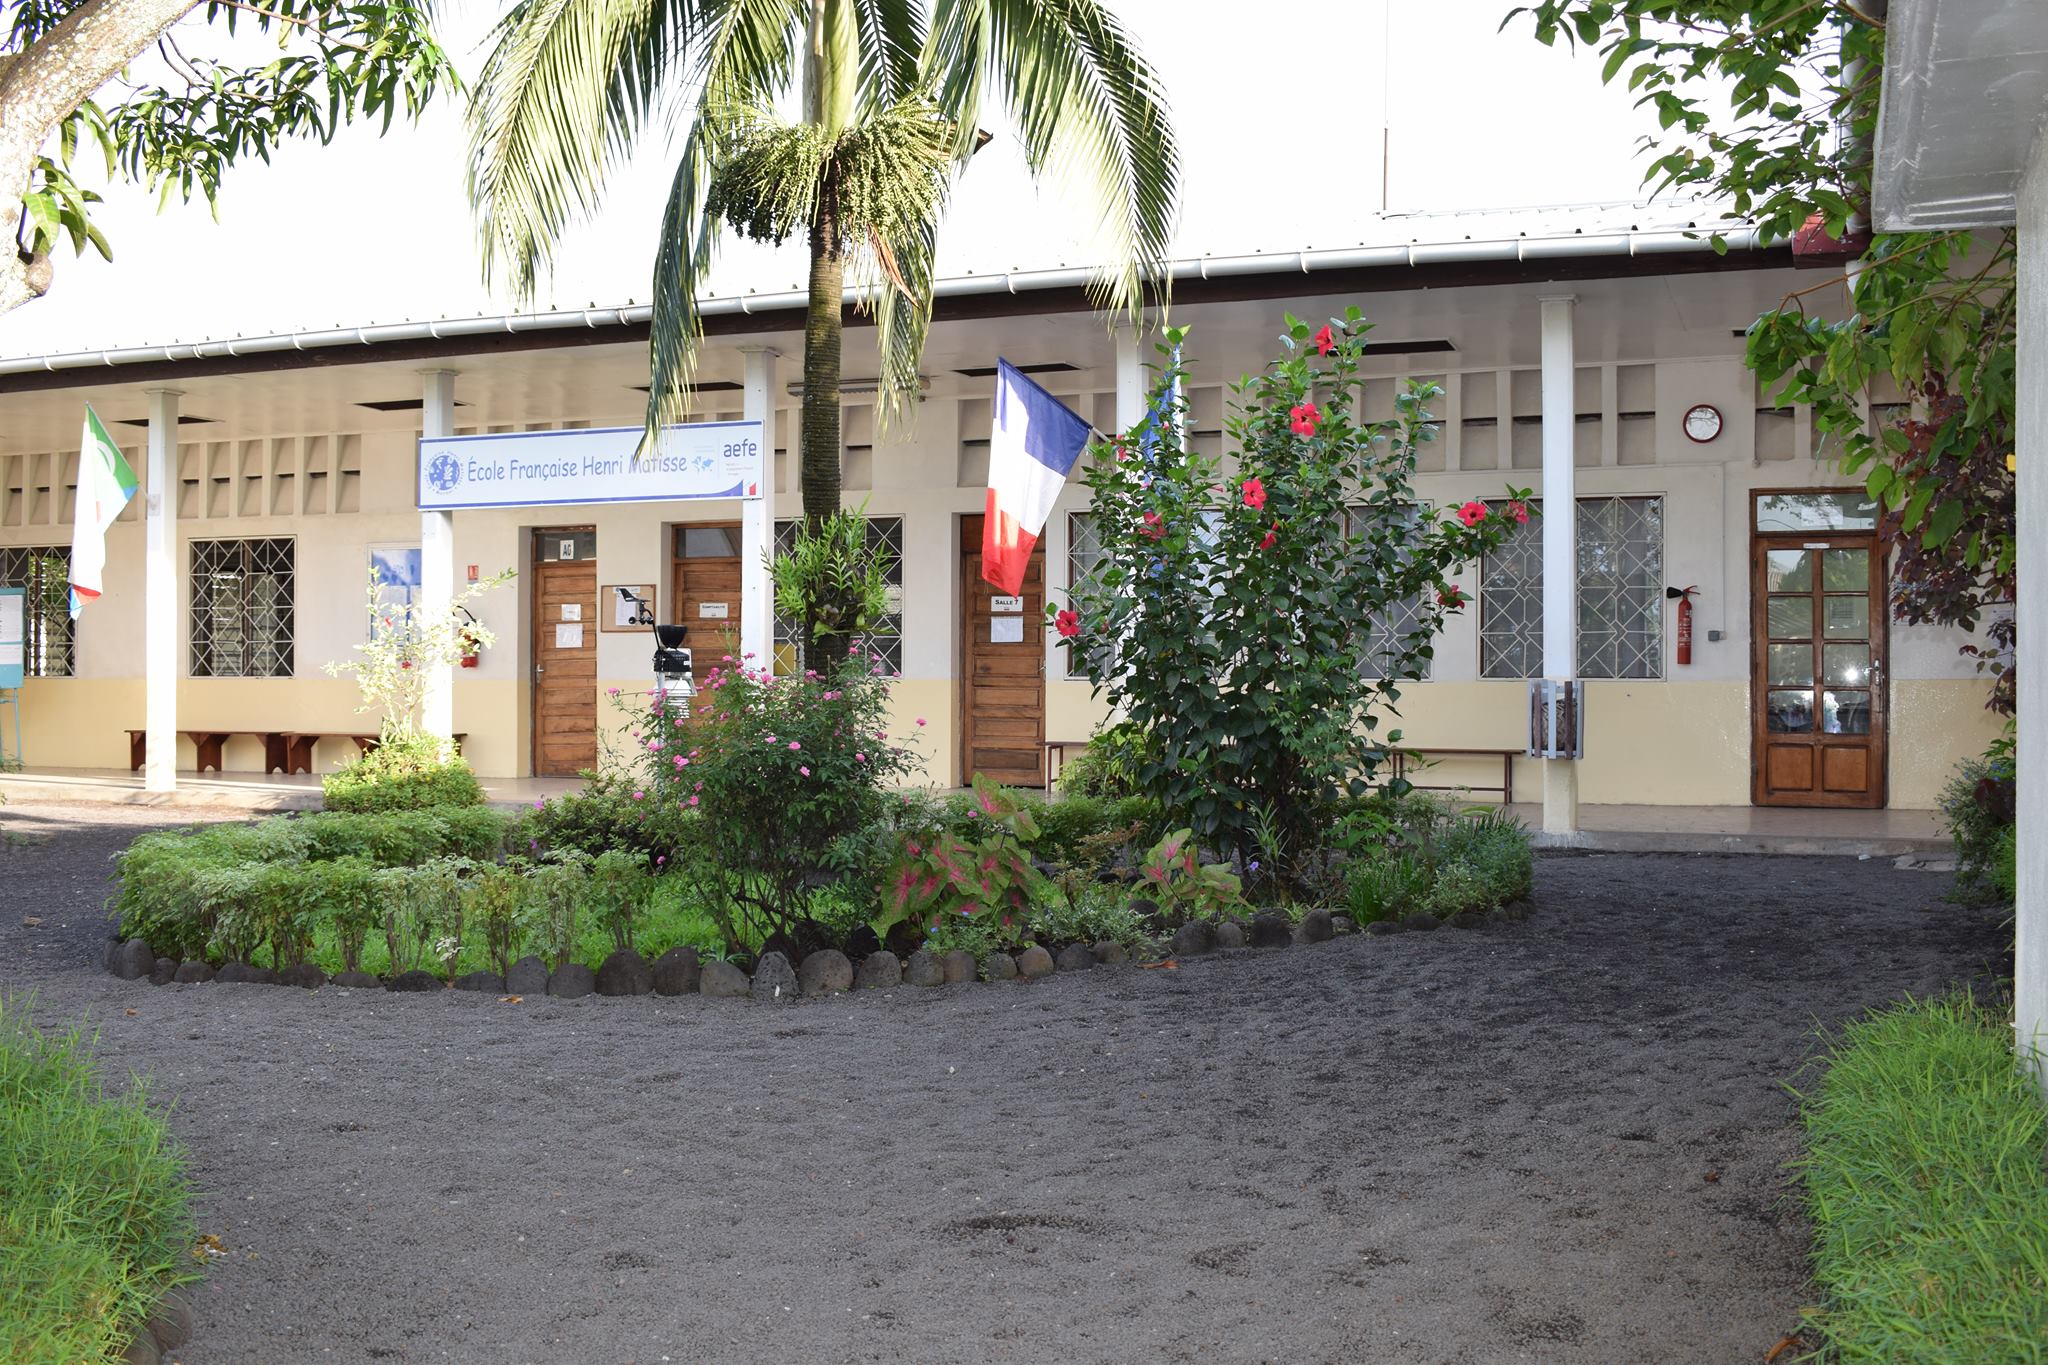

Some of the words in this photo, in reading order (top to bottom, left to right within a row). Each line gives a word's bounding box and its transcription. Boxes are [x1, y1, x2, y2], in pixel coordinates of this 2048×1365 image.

[723, 438, 757, 458] aefe
[468, 456, 505, 481] École
[510, 457, 578, 481] Française
[583, 454, 623, 477] Henri
[629, 453, 688, 474] Matisse
